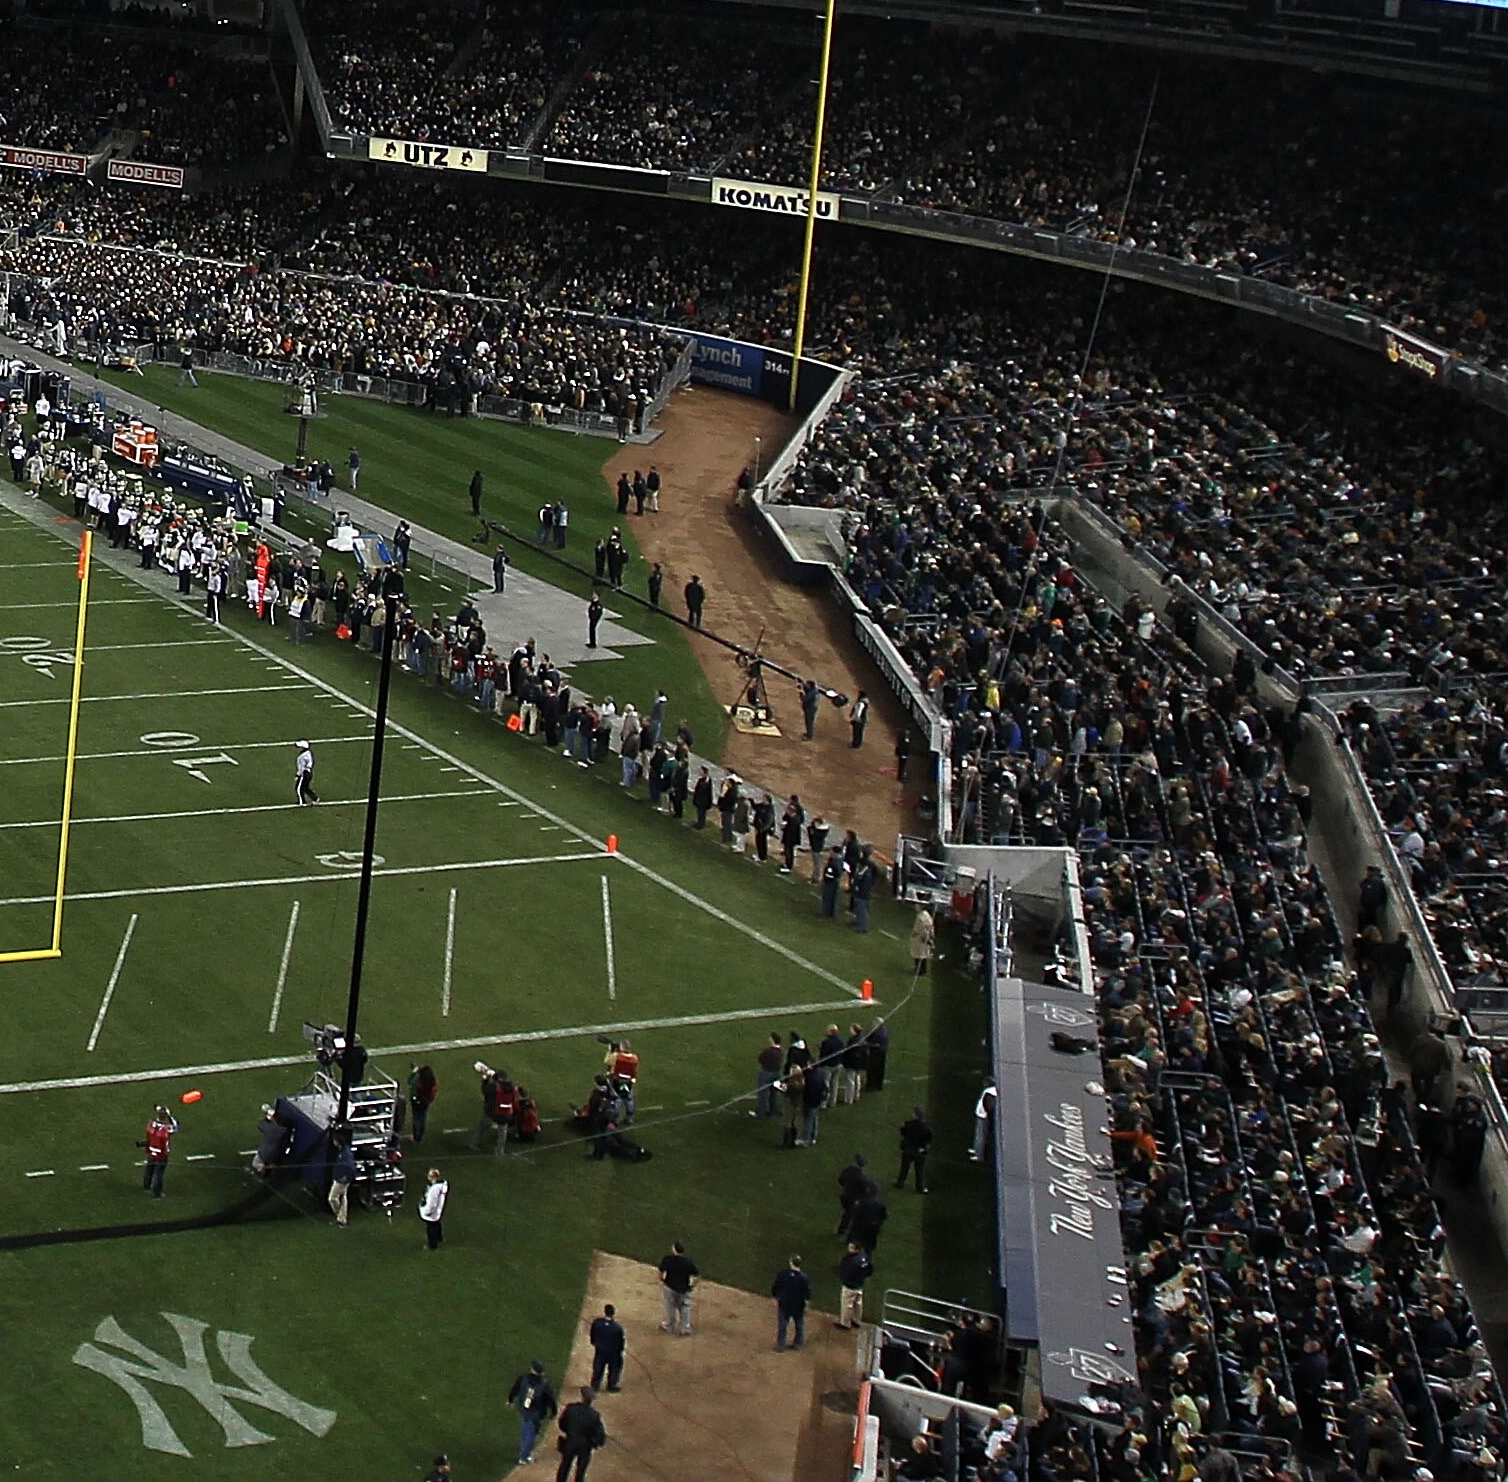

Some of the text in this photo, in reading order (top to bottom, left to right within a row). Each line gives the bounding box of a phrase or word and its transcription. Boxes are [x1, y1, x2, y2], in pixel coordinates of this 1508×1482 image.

[13, 152, 81, 171] MODELL'S
[404, 144, 448, 167] UTZ
[111, 164, 181, 183] MODELL'S
[1045, 1103, 1112, 1240] New York Yankees
[72, 1312, 338, 1459] NY
